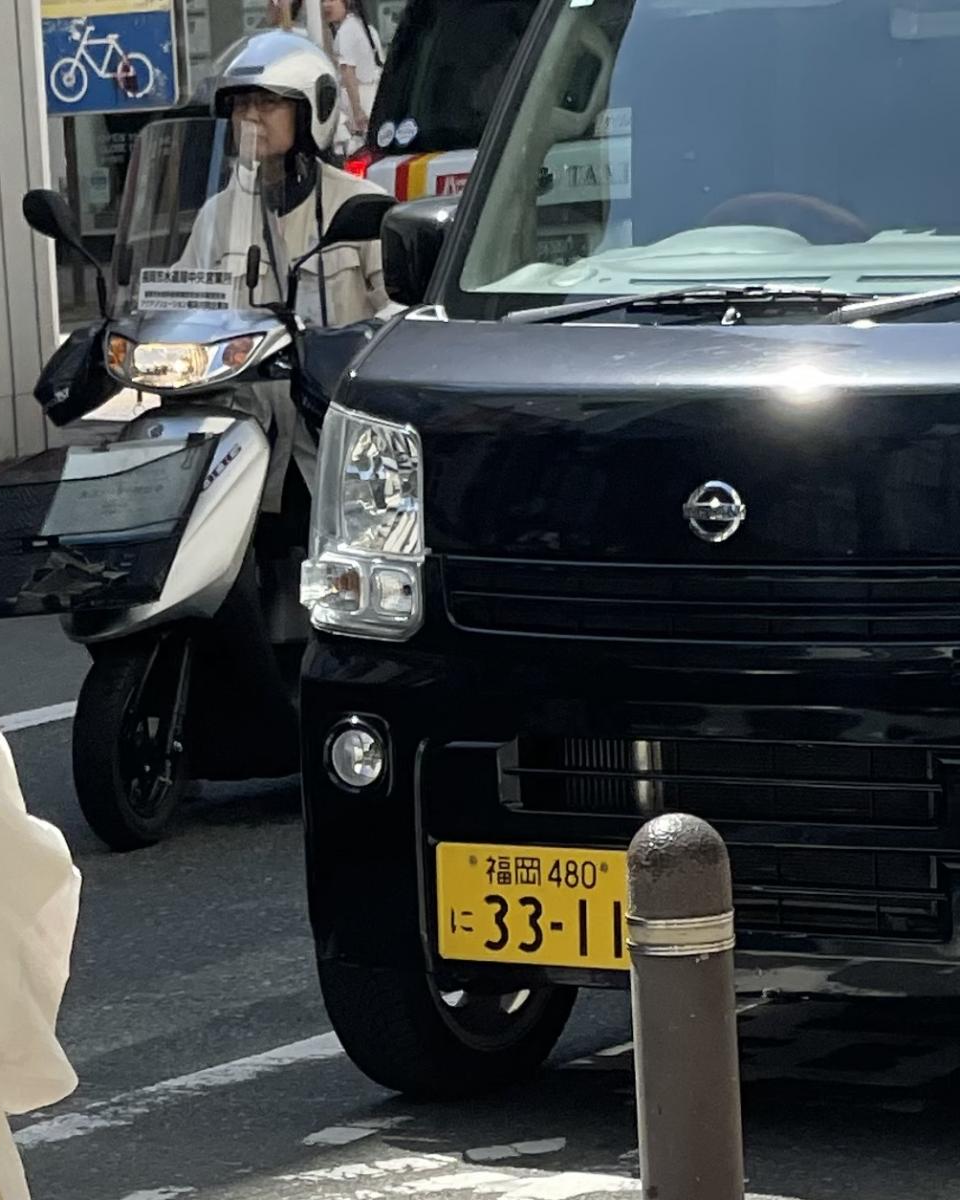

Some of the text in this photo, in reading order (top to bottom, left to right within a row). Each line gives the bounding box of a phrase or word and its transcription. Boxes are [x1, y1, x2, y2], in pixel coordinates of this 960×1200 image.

[486, 856, 597, 889] 福岡 480
[451, 894, 623, 959] に 33-11
